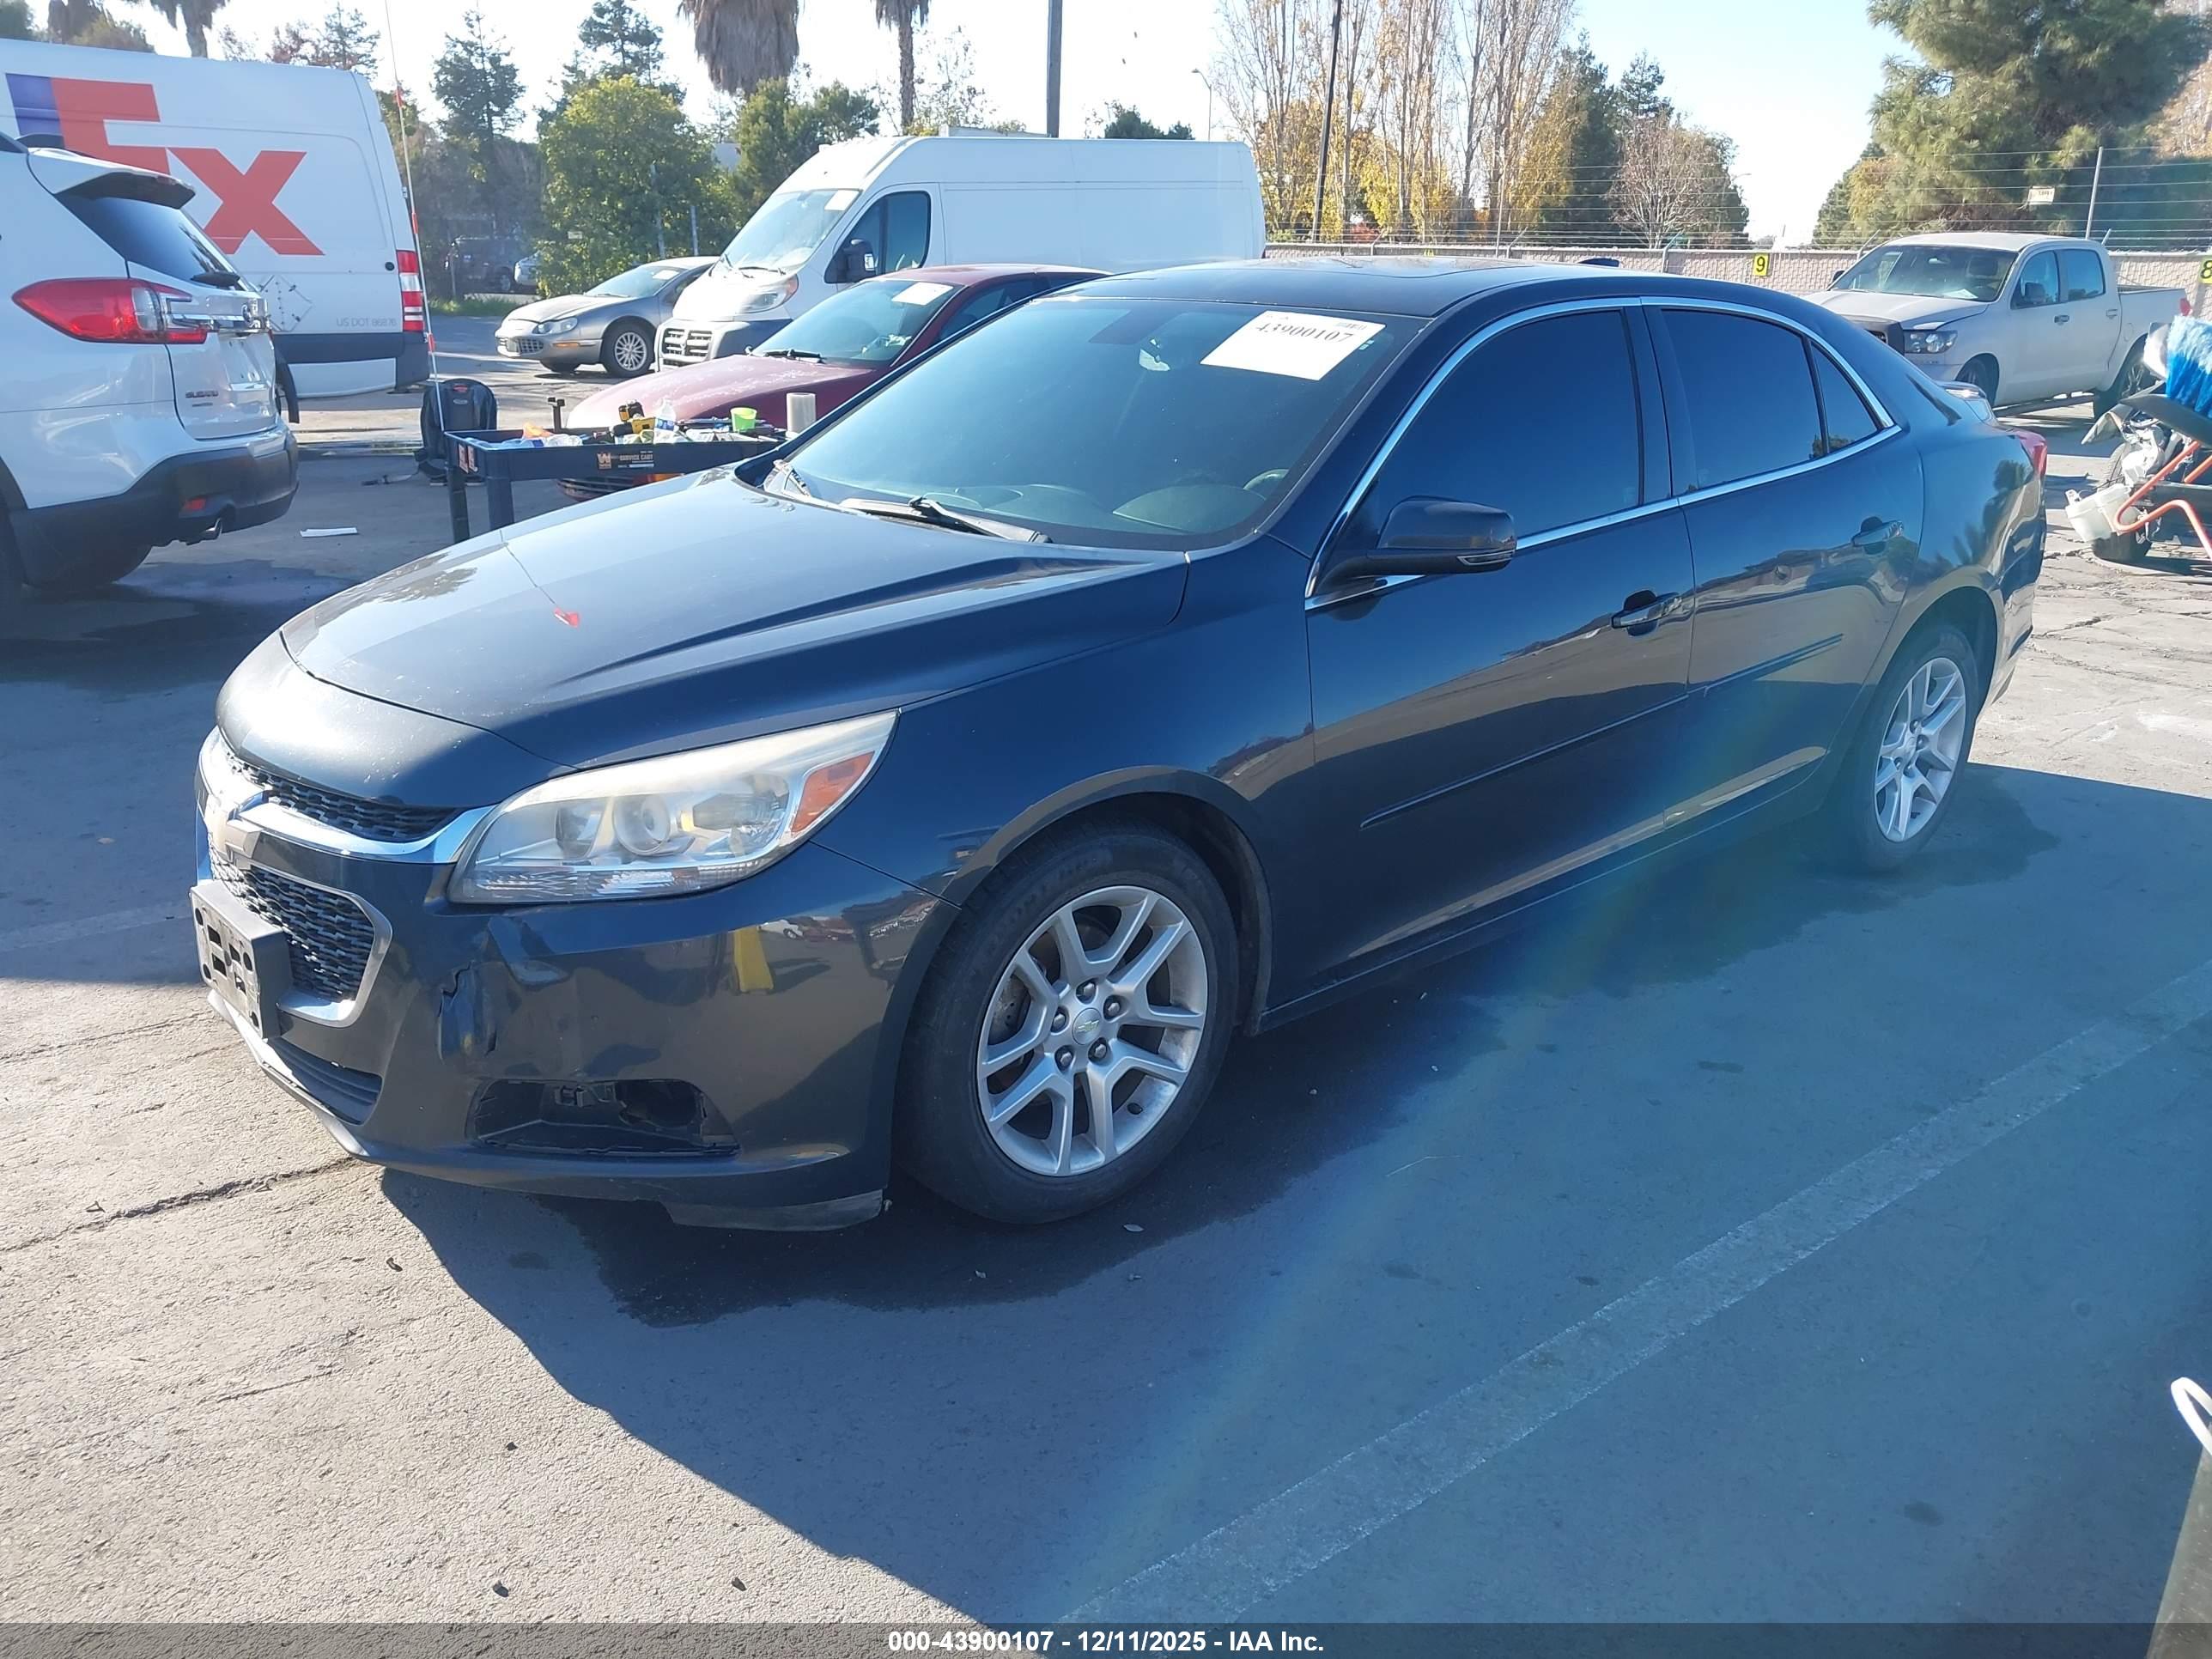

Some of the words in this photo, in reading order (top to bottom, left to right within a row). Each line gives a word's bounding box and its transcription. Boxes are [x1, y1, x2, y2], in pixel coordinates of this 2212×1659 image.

[1755, 255, 1766, 274] 9
[2200, 259, 2212, 279] 8
[336, 316, 350, 328] US
[351, 316, 369, 328] DOT
